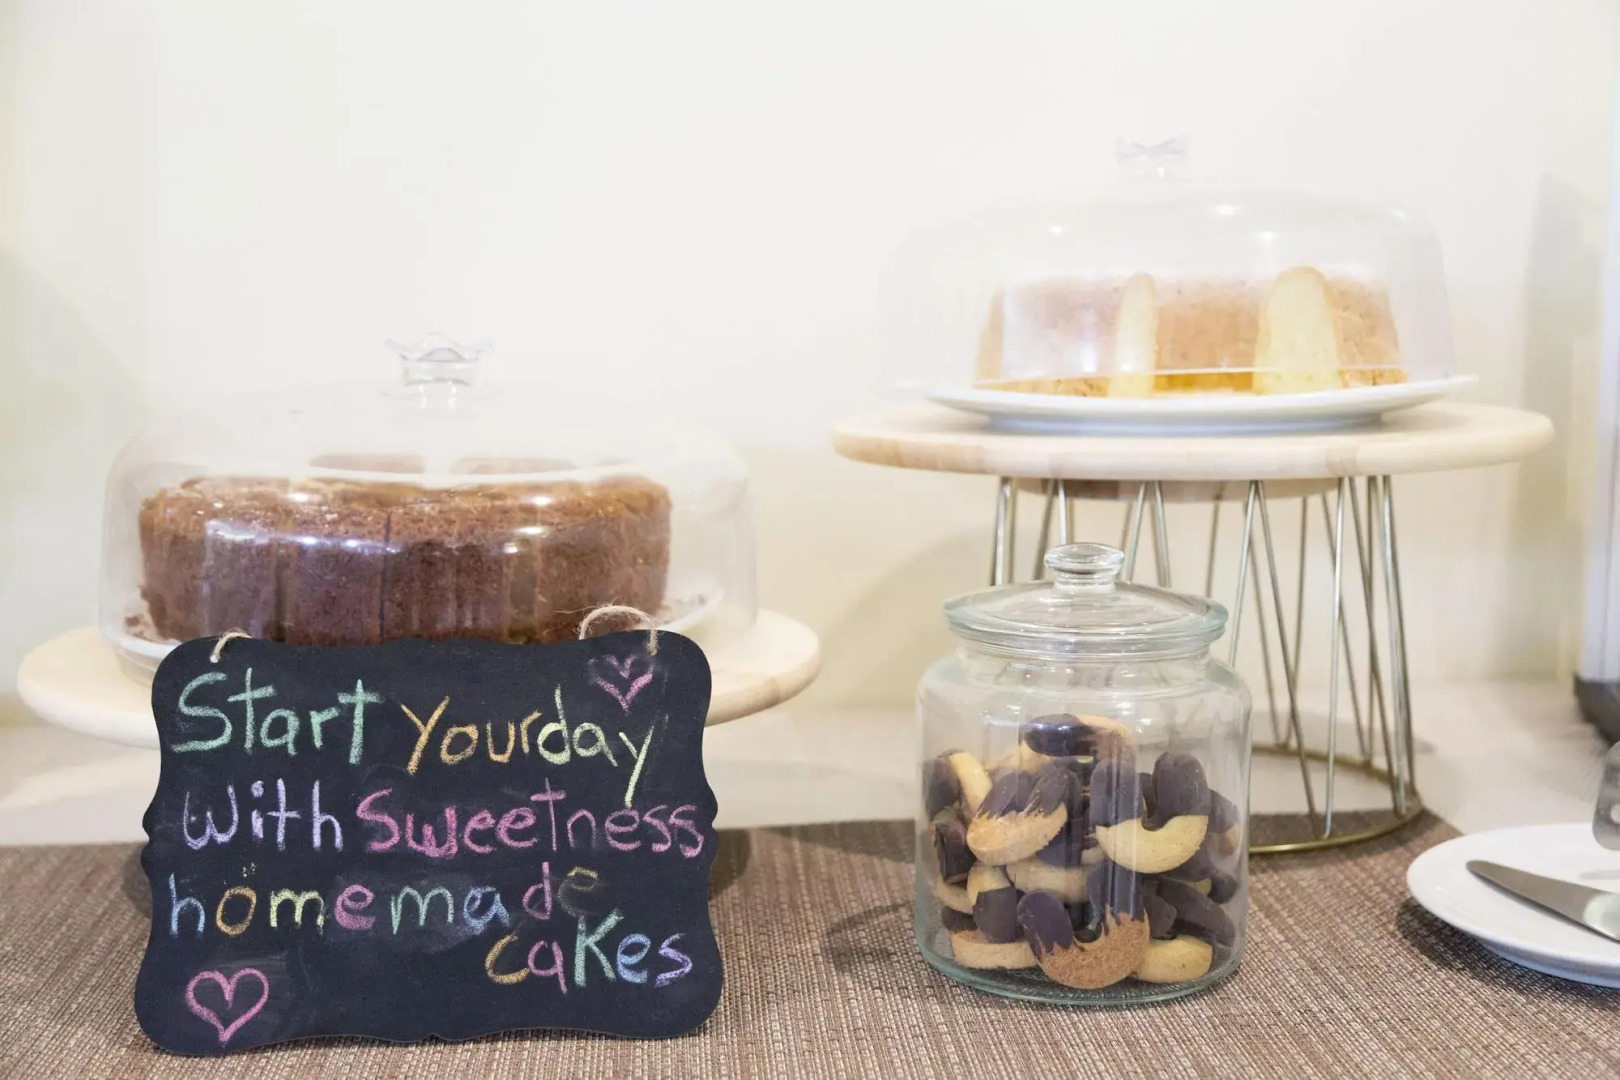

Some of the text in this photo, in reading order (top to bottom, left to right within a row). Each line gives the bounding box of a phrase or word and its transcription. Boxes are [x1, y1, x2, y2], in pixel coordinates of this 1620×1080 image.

[171, 667, 380, 765] Start
[355, 776, 705, 858] Sweetness
[168, 861, 600, 936] homemade
